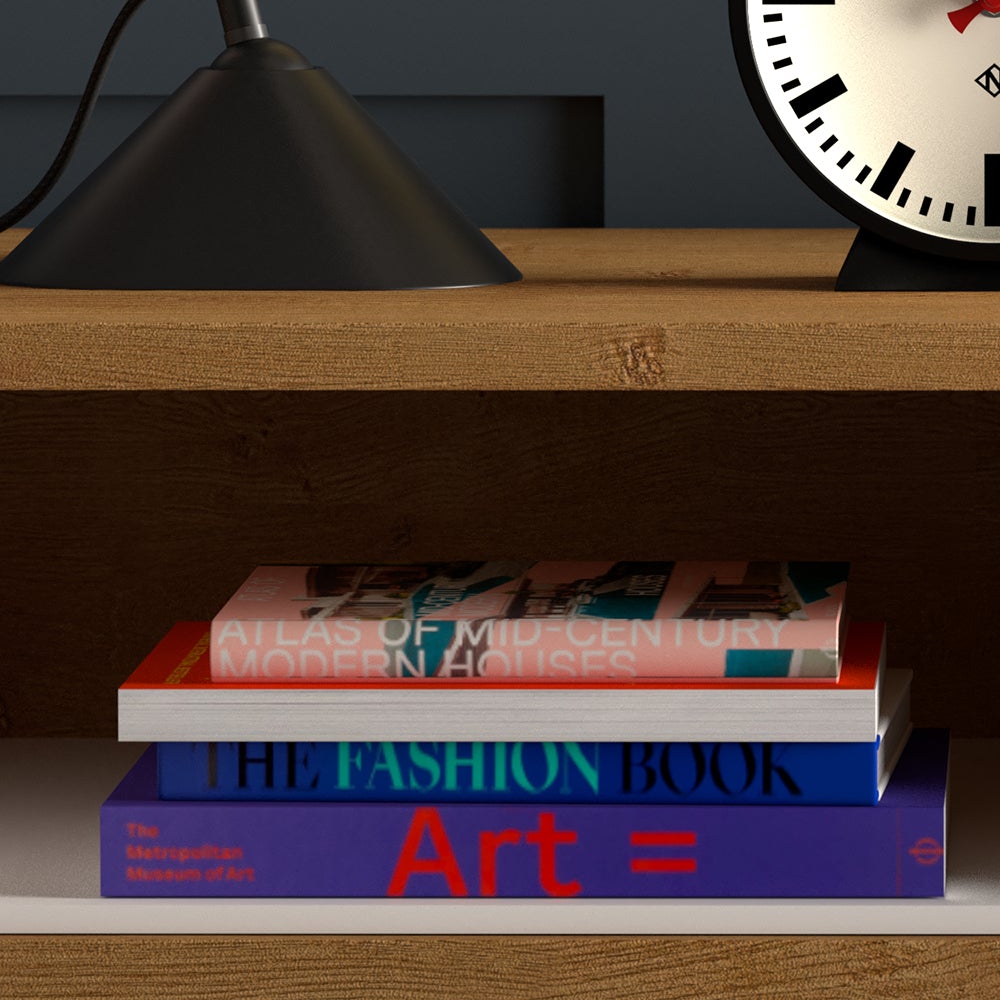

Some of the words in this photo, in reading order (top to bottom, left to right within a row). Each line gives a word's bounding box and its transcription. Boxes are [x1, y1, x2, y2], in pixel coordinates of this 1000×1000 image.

[217, 618, 362, 646] ATLAS
[377, 618, 439, 646] OF
[453, 618, 789, 647] MID-CENTURY
[219, 648, 424, 678] MODERN
[442, 648, 637, 678] HOUSES
[191, 742, 320, 790] THE
[333, 742, 600, 793] FASHION
[620, 742, 803, 797] BOOK
[126, 822, 160, 839] The
[126, 844, 243, 863] Metropolitan
[387, 806, 583, 897] Art
[126, 866, 202, 882] Museum
[205, 865, 225, 882] of
[226, 866, 255, 882] Art
